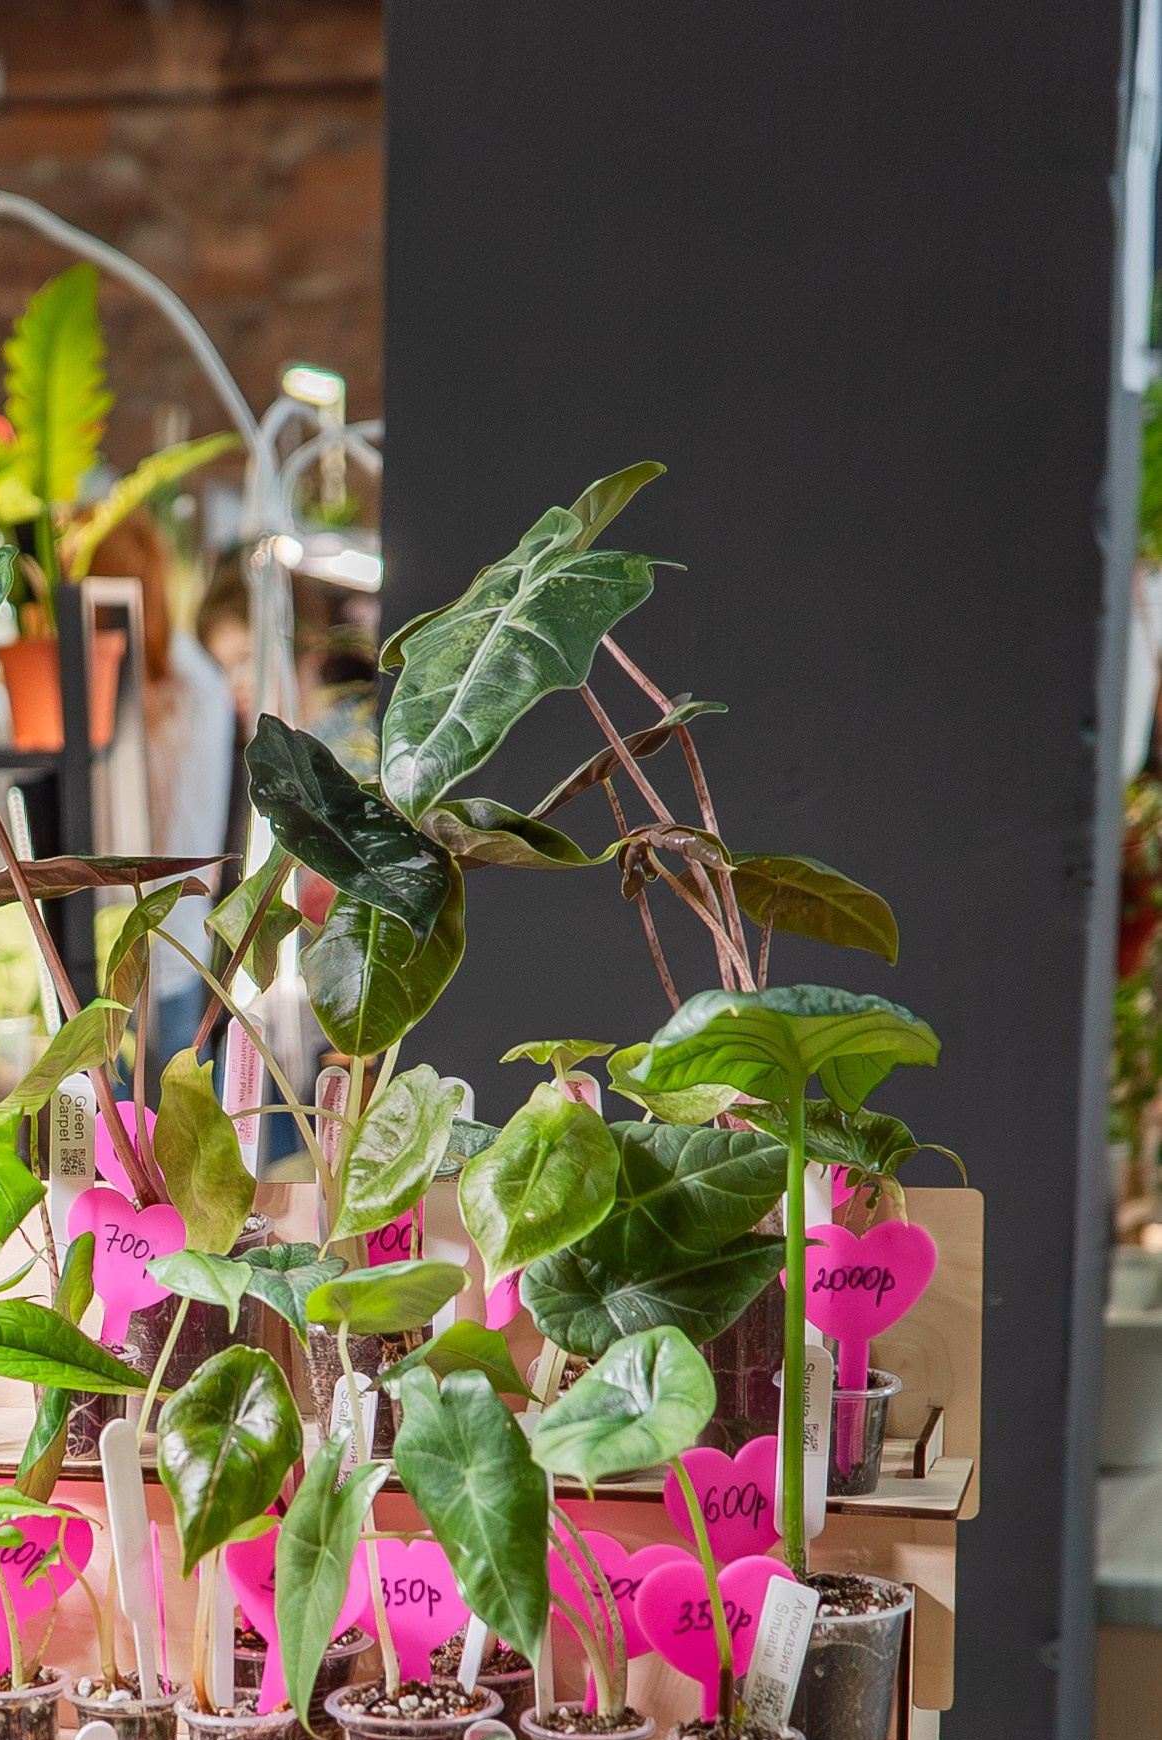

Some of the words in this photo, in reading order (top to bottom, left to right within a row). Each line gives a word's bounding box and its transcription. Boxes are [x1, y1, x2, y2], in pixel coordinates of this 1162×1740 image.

[57, 1093, 72, 1142] Carpet
[71, 1095, 87, 1142] Green
[778, 1596, 809, 1677] Алоказия
